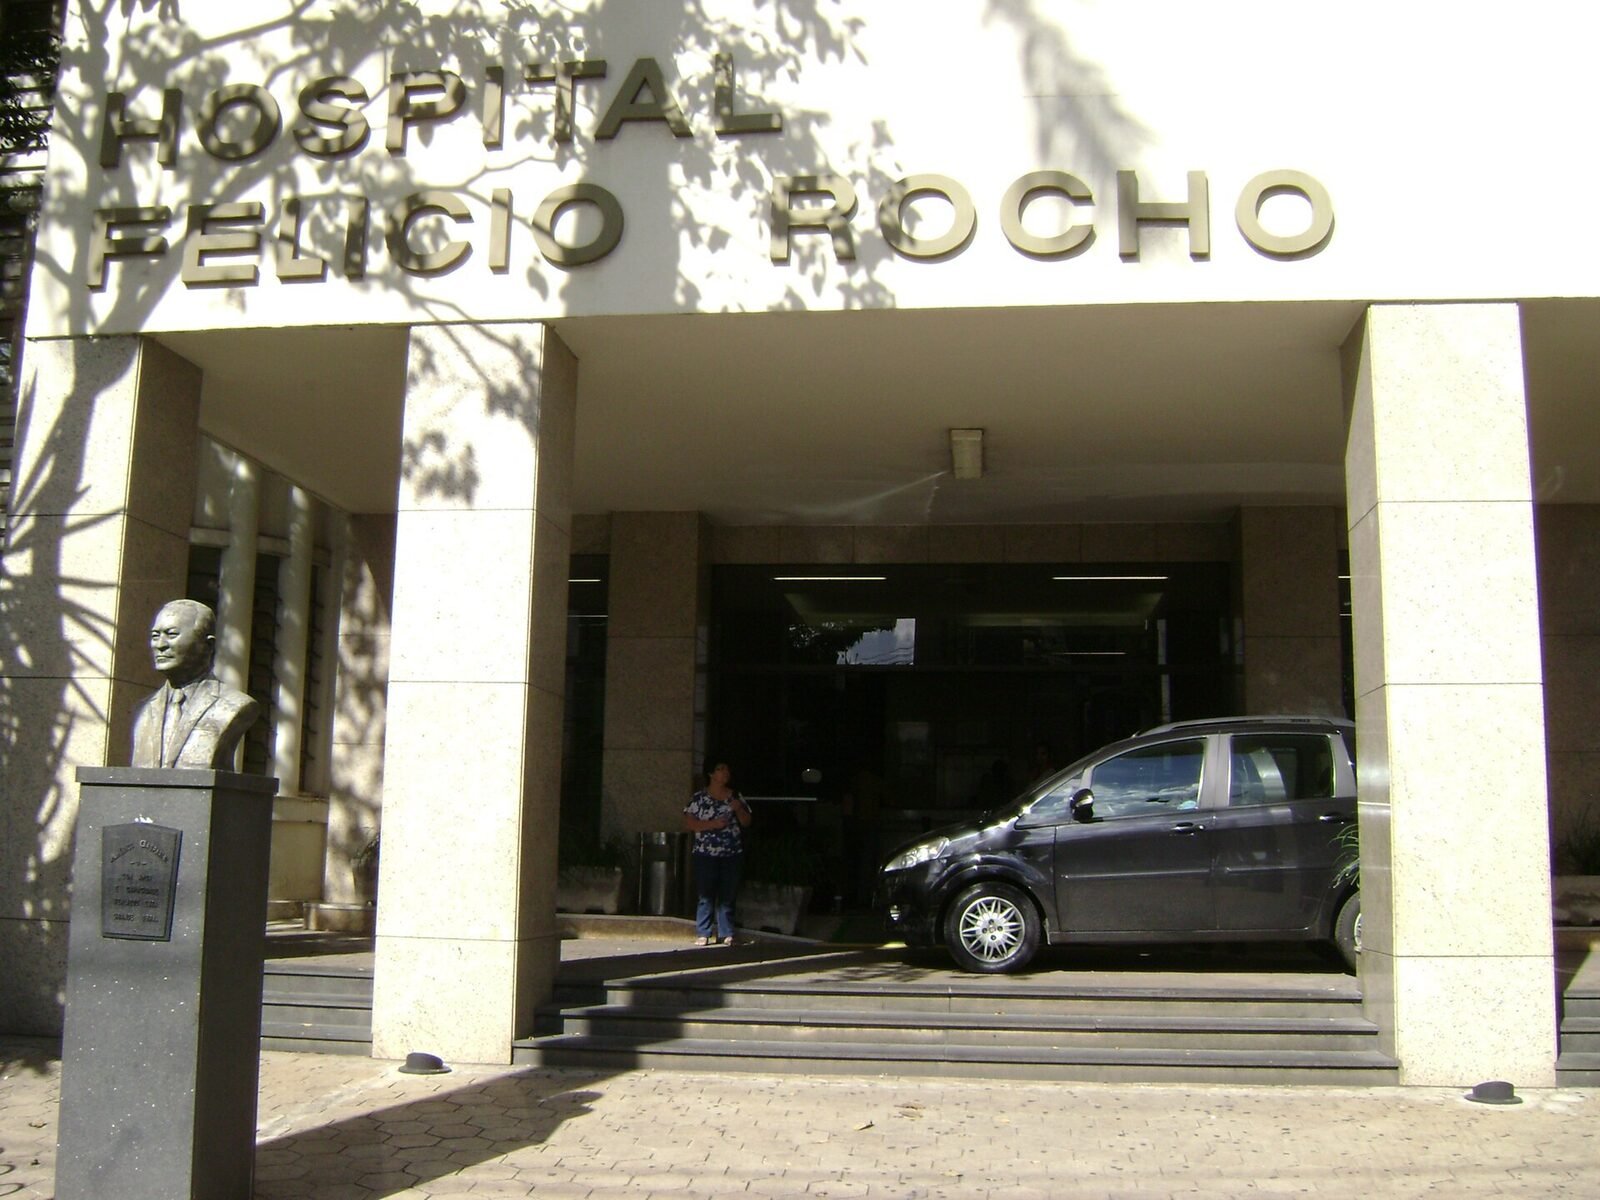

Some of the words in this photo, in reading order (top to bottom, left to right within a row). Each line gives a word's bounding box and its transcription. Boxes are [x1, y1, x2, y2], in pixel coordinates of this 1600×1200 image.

[101, 53, 783, 167] HOSPITAL
[87, 182, 625, 290] FELICIO
[770, 169, 1336, 263] ROCHO
